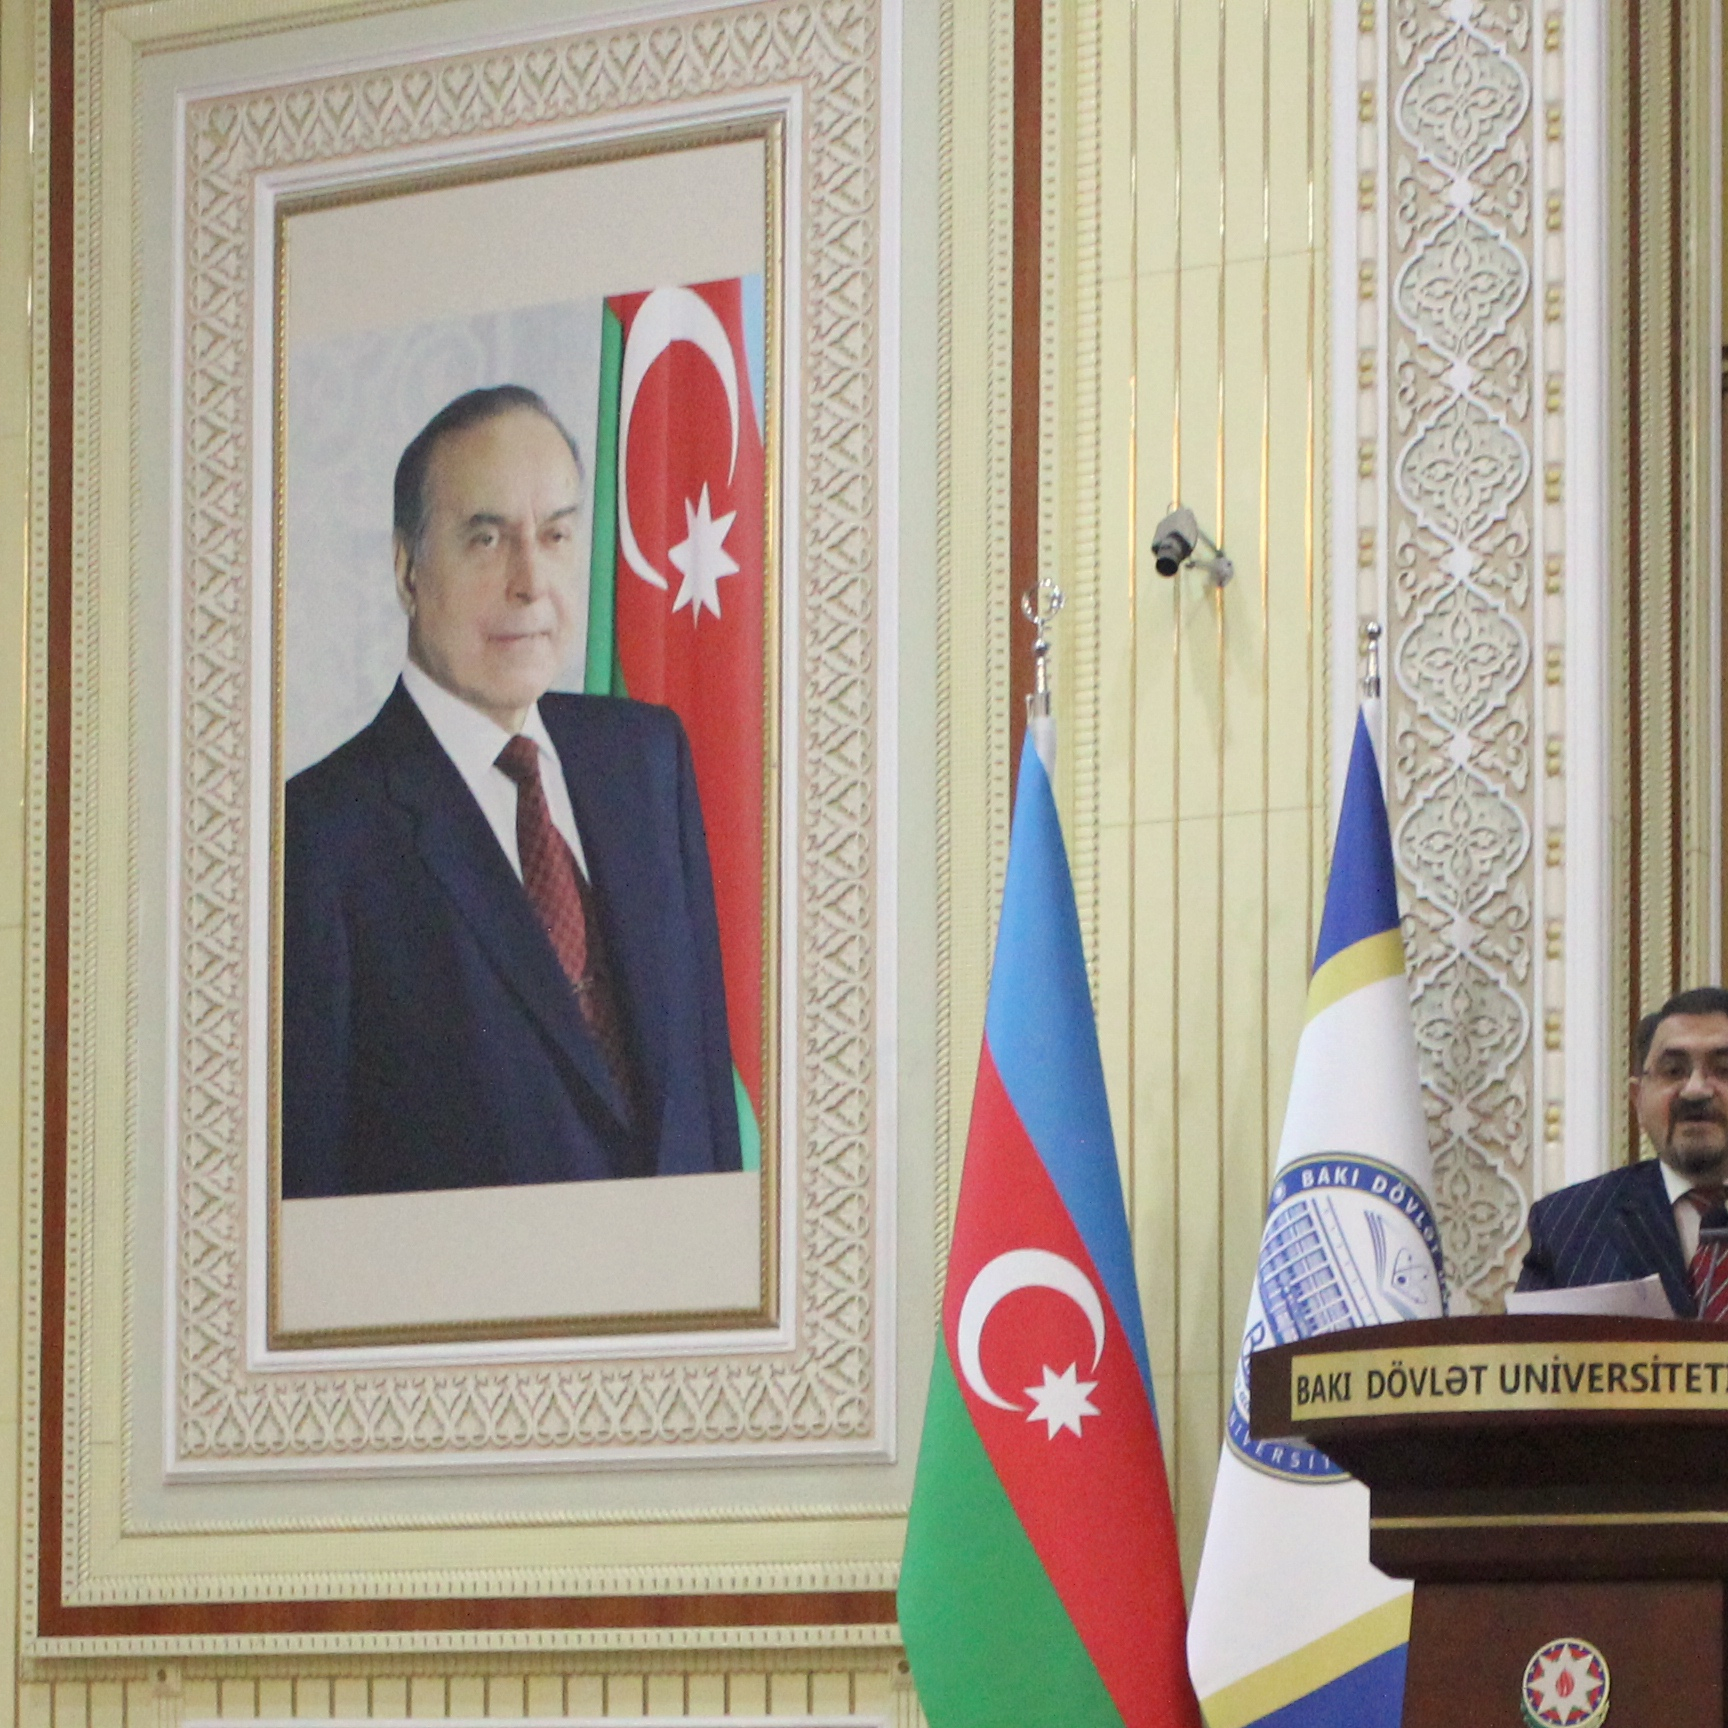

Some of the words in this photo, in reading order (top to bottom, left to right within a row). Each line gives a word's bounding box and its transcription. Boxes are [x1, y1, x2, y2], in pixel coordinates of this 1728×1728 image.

[1301, 1166, 1360, 1189] BAKI
[1296, 1372, 1352, 1406] BAKI
[1367, 1361, 1488, 1400] DÖVLƏT
